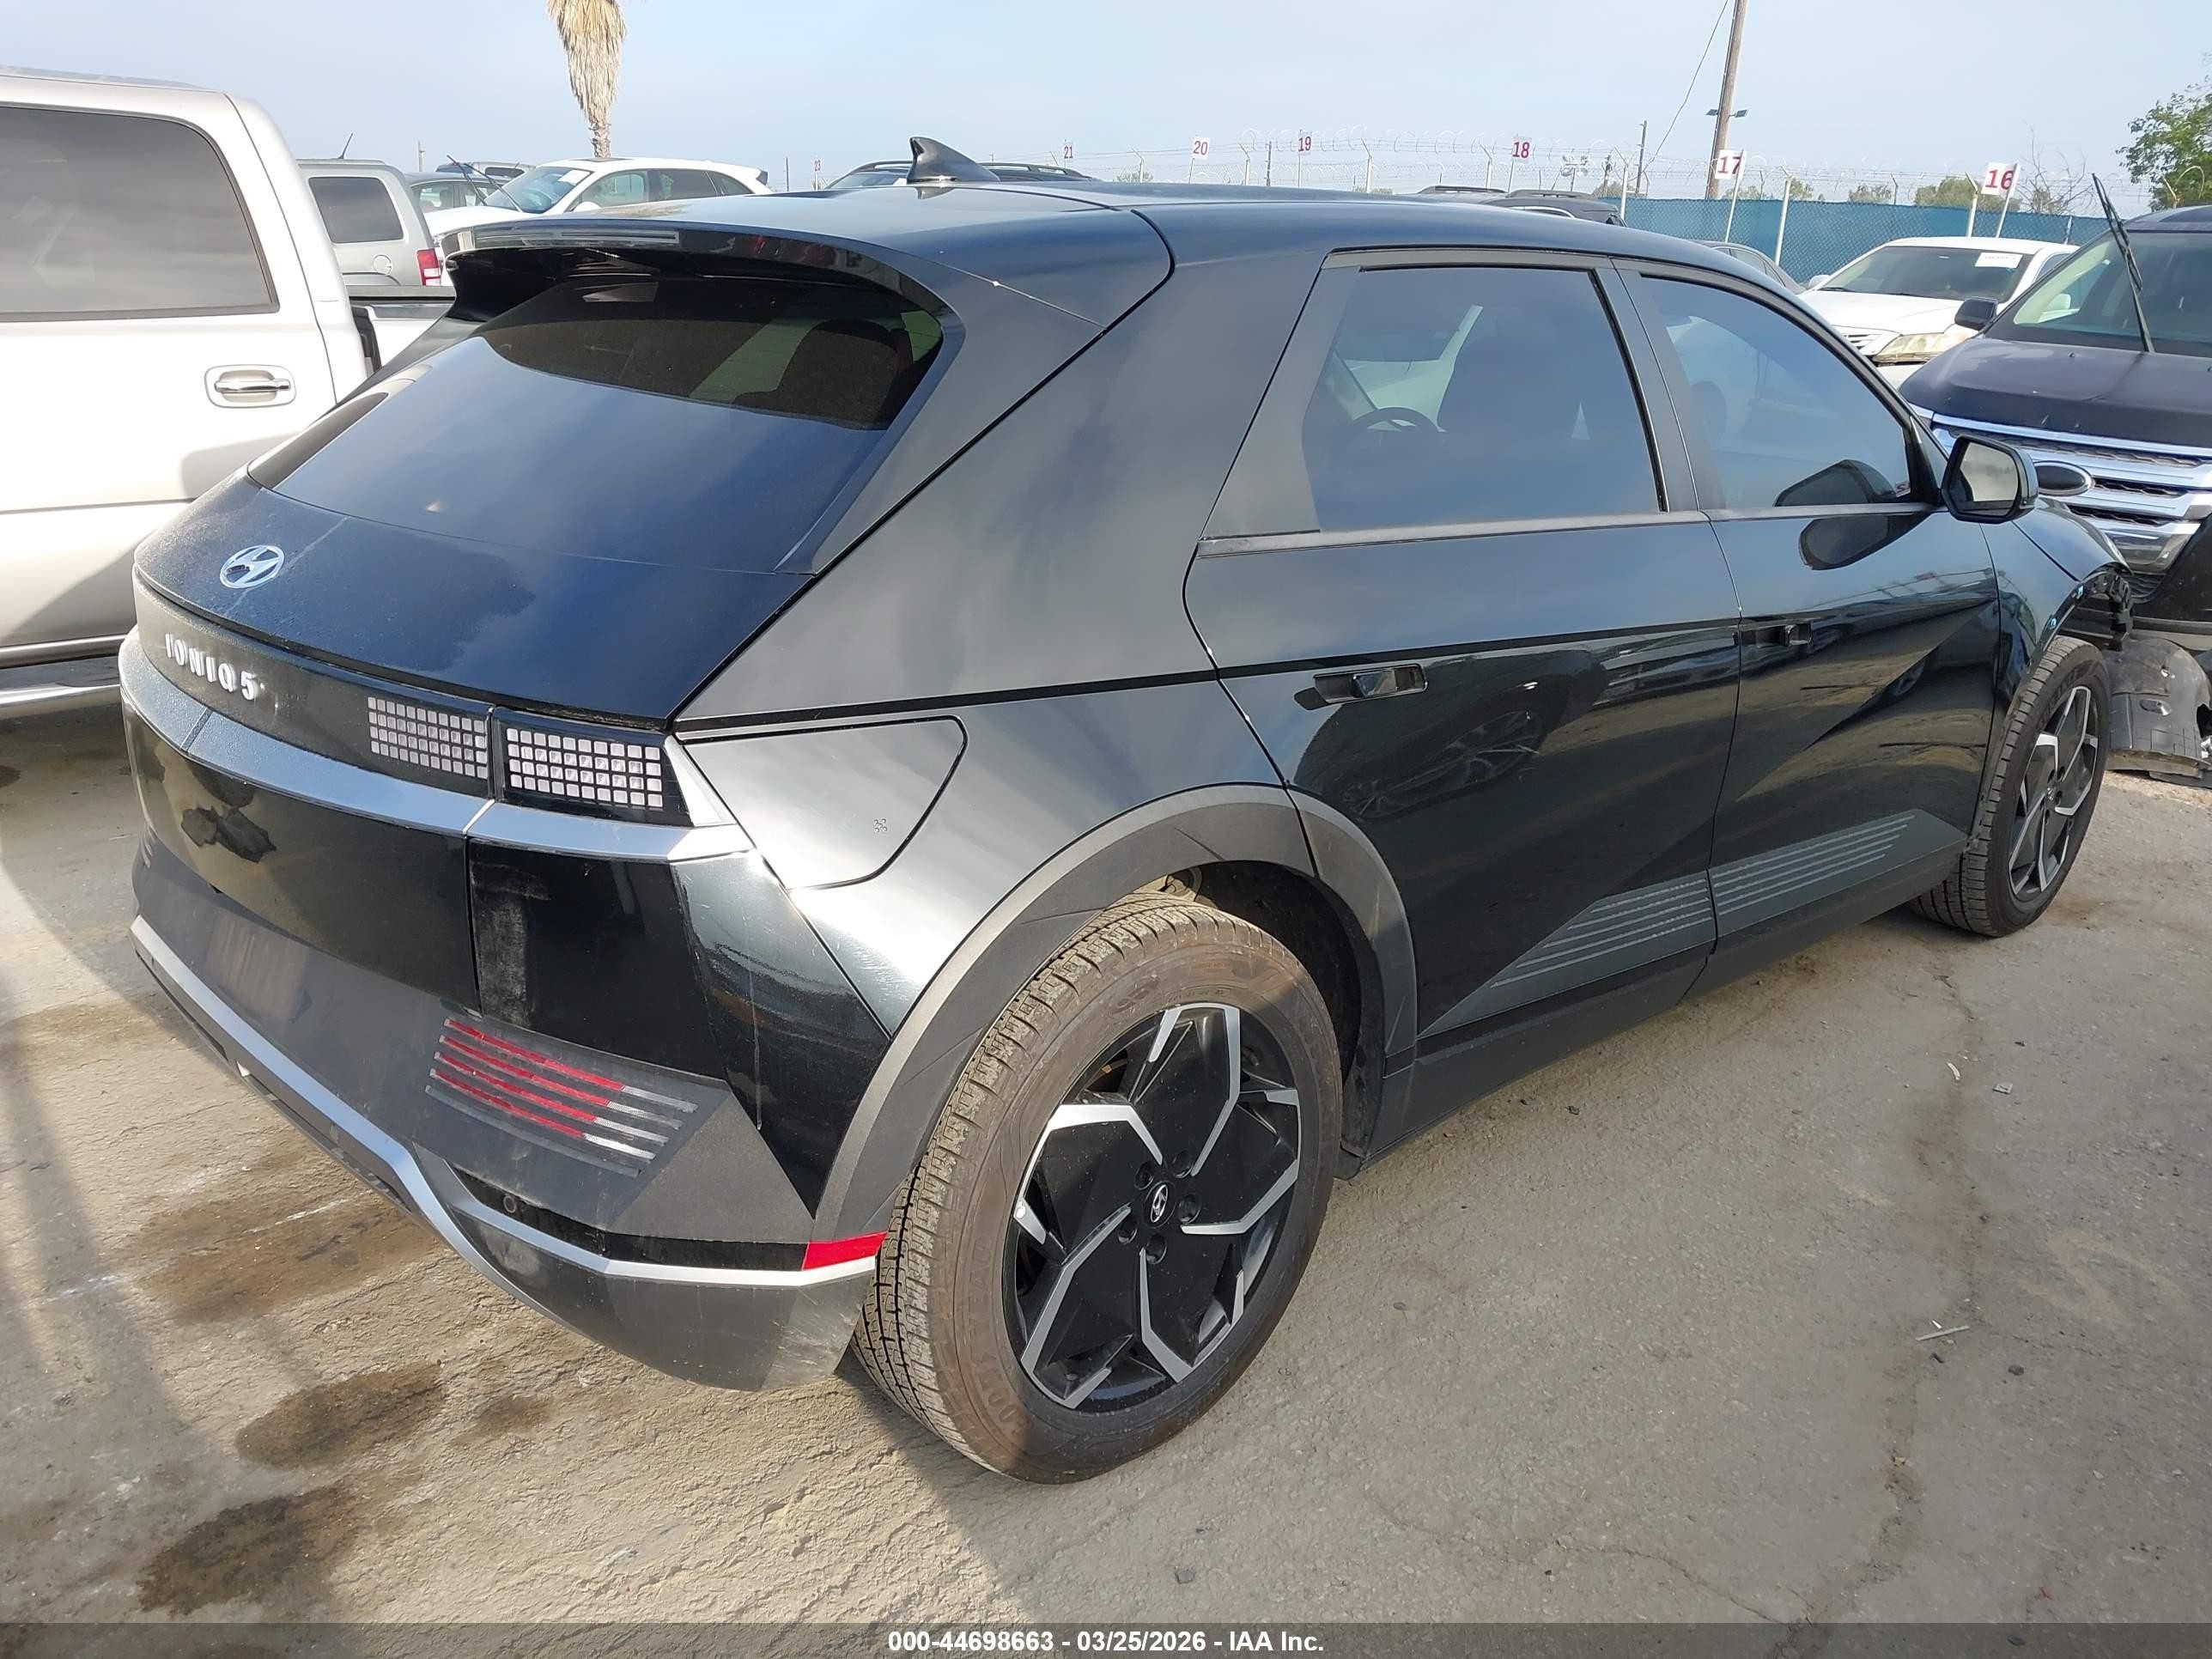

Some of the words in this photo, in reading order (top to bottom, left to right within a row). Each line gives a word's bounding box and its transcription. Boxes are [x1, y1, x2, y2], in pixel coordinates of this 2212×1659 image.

[1064, 145, 1073, 159] 21
[1193, 140, 1208, 156] 20
[1297, 136, 1311, 152] 19
[1512, 141, 1530, 159] 18
[1717, 156, 1742, 174] 17
[1985, 169, 2014, 190] 16
[165, 634, 236, 692] IONIQ
[241, 671, 258, 700] 5
